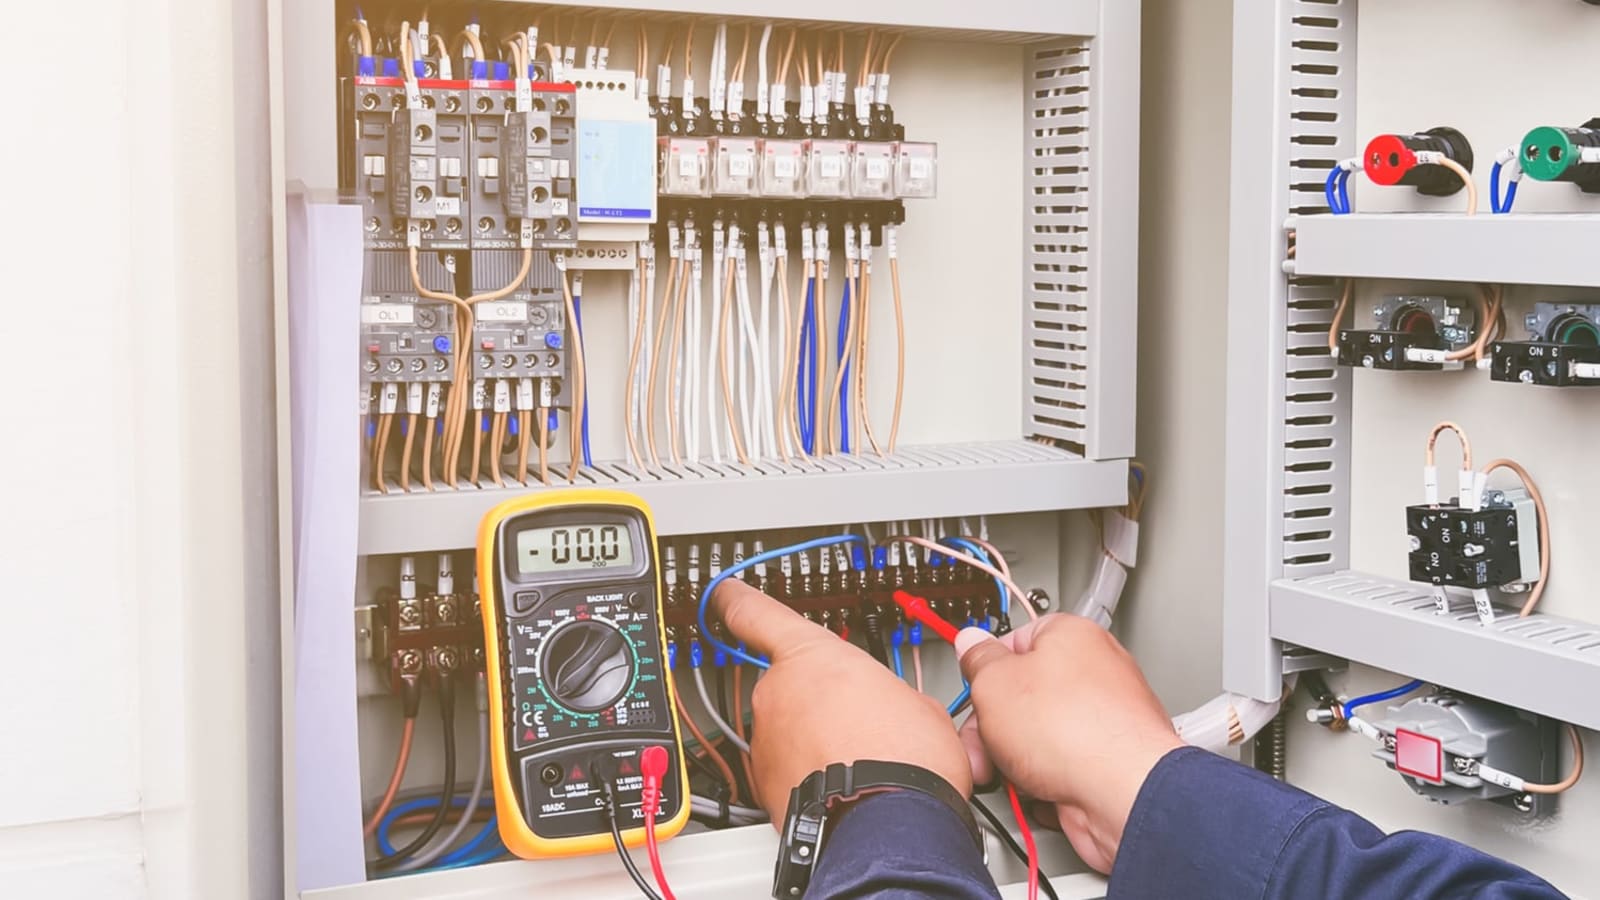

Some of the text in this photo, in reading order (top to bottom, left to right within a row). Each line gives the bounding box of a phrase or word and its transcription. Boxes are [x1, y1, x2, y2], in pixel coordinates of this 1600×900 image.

[683, 160, 694, 169] R1
[733, 160, 745, 169] R2
[379, 310, 400, 322] OL1
[496, 306, 519, 318] OL2
[1369, 334, 1382, 343] NC
[1528, 345, 1544, 357] NO
[1551, 347, 1559, 358] 3
[1441, 528, 1451, 543] NO
[592, 560, 607, 568] 200
[1430, 552, 1440, 567] NO
[402, 574, 416, 582] R
[587, 595, 605, 603] BACK
